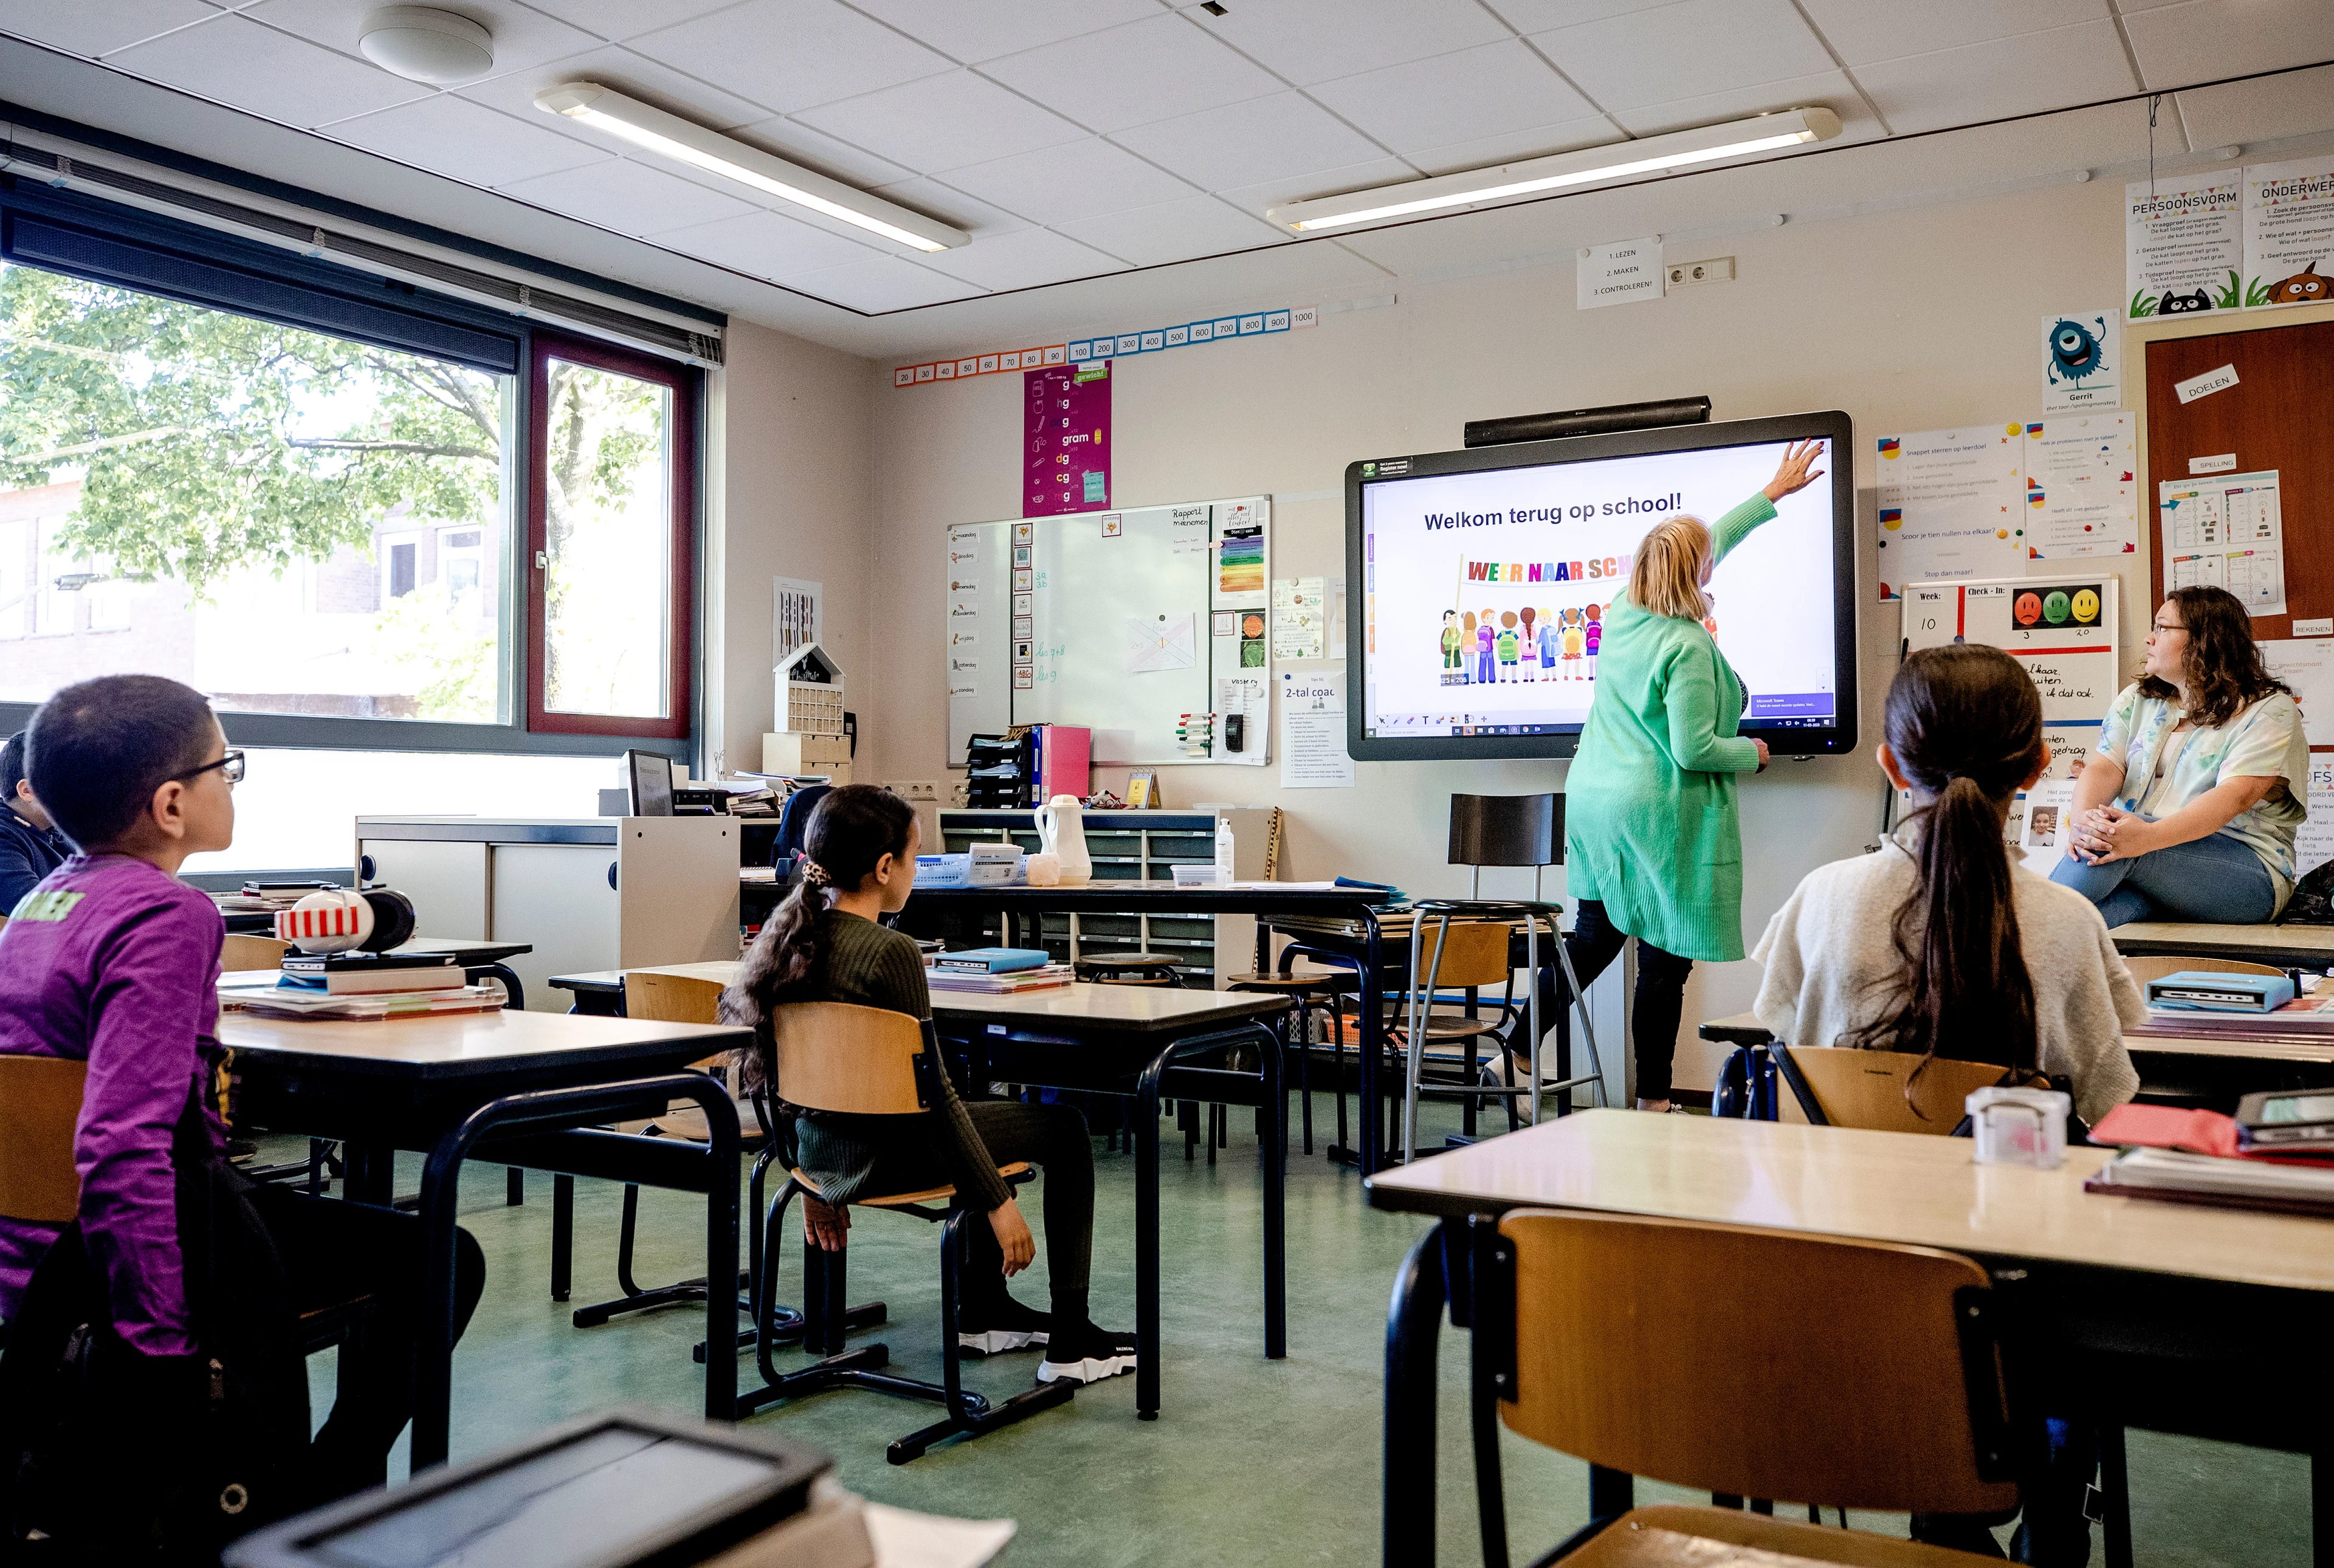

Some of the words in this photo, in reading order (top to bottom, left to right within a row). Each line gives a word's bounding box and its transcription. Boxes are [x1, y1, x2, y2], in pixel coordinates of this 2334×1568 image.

[2262, 181, 2334, 198] ONDERWER
[2133, 193, 2236, 214] PERSOONSVORM
[2152, 219, 2185, 228] Vraagproef
[1616, 249, 1636, 258] LEZEN
[2142, 244, 2177, 253] Getalsproef
[1614, 266, 1639, 275] MAKEN
[2146, 270, 2174, 278] Tijdsproef
[1601, 281, 1652, 294] CONTROLEREN!
[1123, 340, 1135, 348] 300
[1146, 337, 1158, 346] 400
[1171, 332, 1184, 341] 500
[1196, 328, 1209, 337] 600
[1245, 321, 1259, 329] 800
[1271, 318, 1285, 326] 900
[1295, 312, 1313, 322] 1000
[1078, 371, 1104, 382] gewicht
[2189, 377, 2229, 397] DOELEN
[1062, 433, 1089, 446] gram
[1056, 453, 1069, 464] dg
[1056, 473, 1070, 484] cg
[1172, 506, 1202, 519] Rapport
[1425, 511, 1502, 531] Welkom
[1509, 506, 1561, 524] terug
[1570, 503, 1595, 522] op
[1603, 492, 1681, 515] school!
[1468, 561, 1523, 582] WEER
[1528, 560, 1583, 582] NAAR
[1589, 554, 1637, 579] SCH
[1036, 572, 1047, 580] 3a
[1922, 618, 1935, 630] 10
[1036, 641, 1048, 657] les
[790, 669, 819, 681] Christmas
[1036, 665, 1048, 681] les
[1050, 670, 1056, 683] 9
[1286, 687, 1309, 698] 2-tal
[2047, 688, 2055, 697] ik
[2059, 689, 2074, 697] dat
[2077, 688, 2094, 698] ook.
